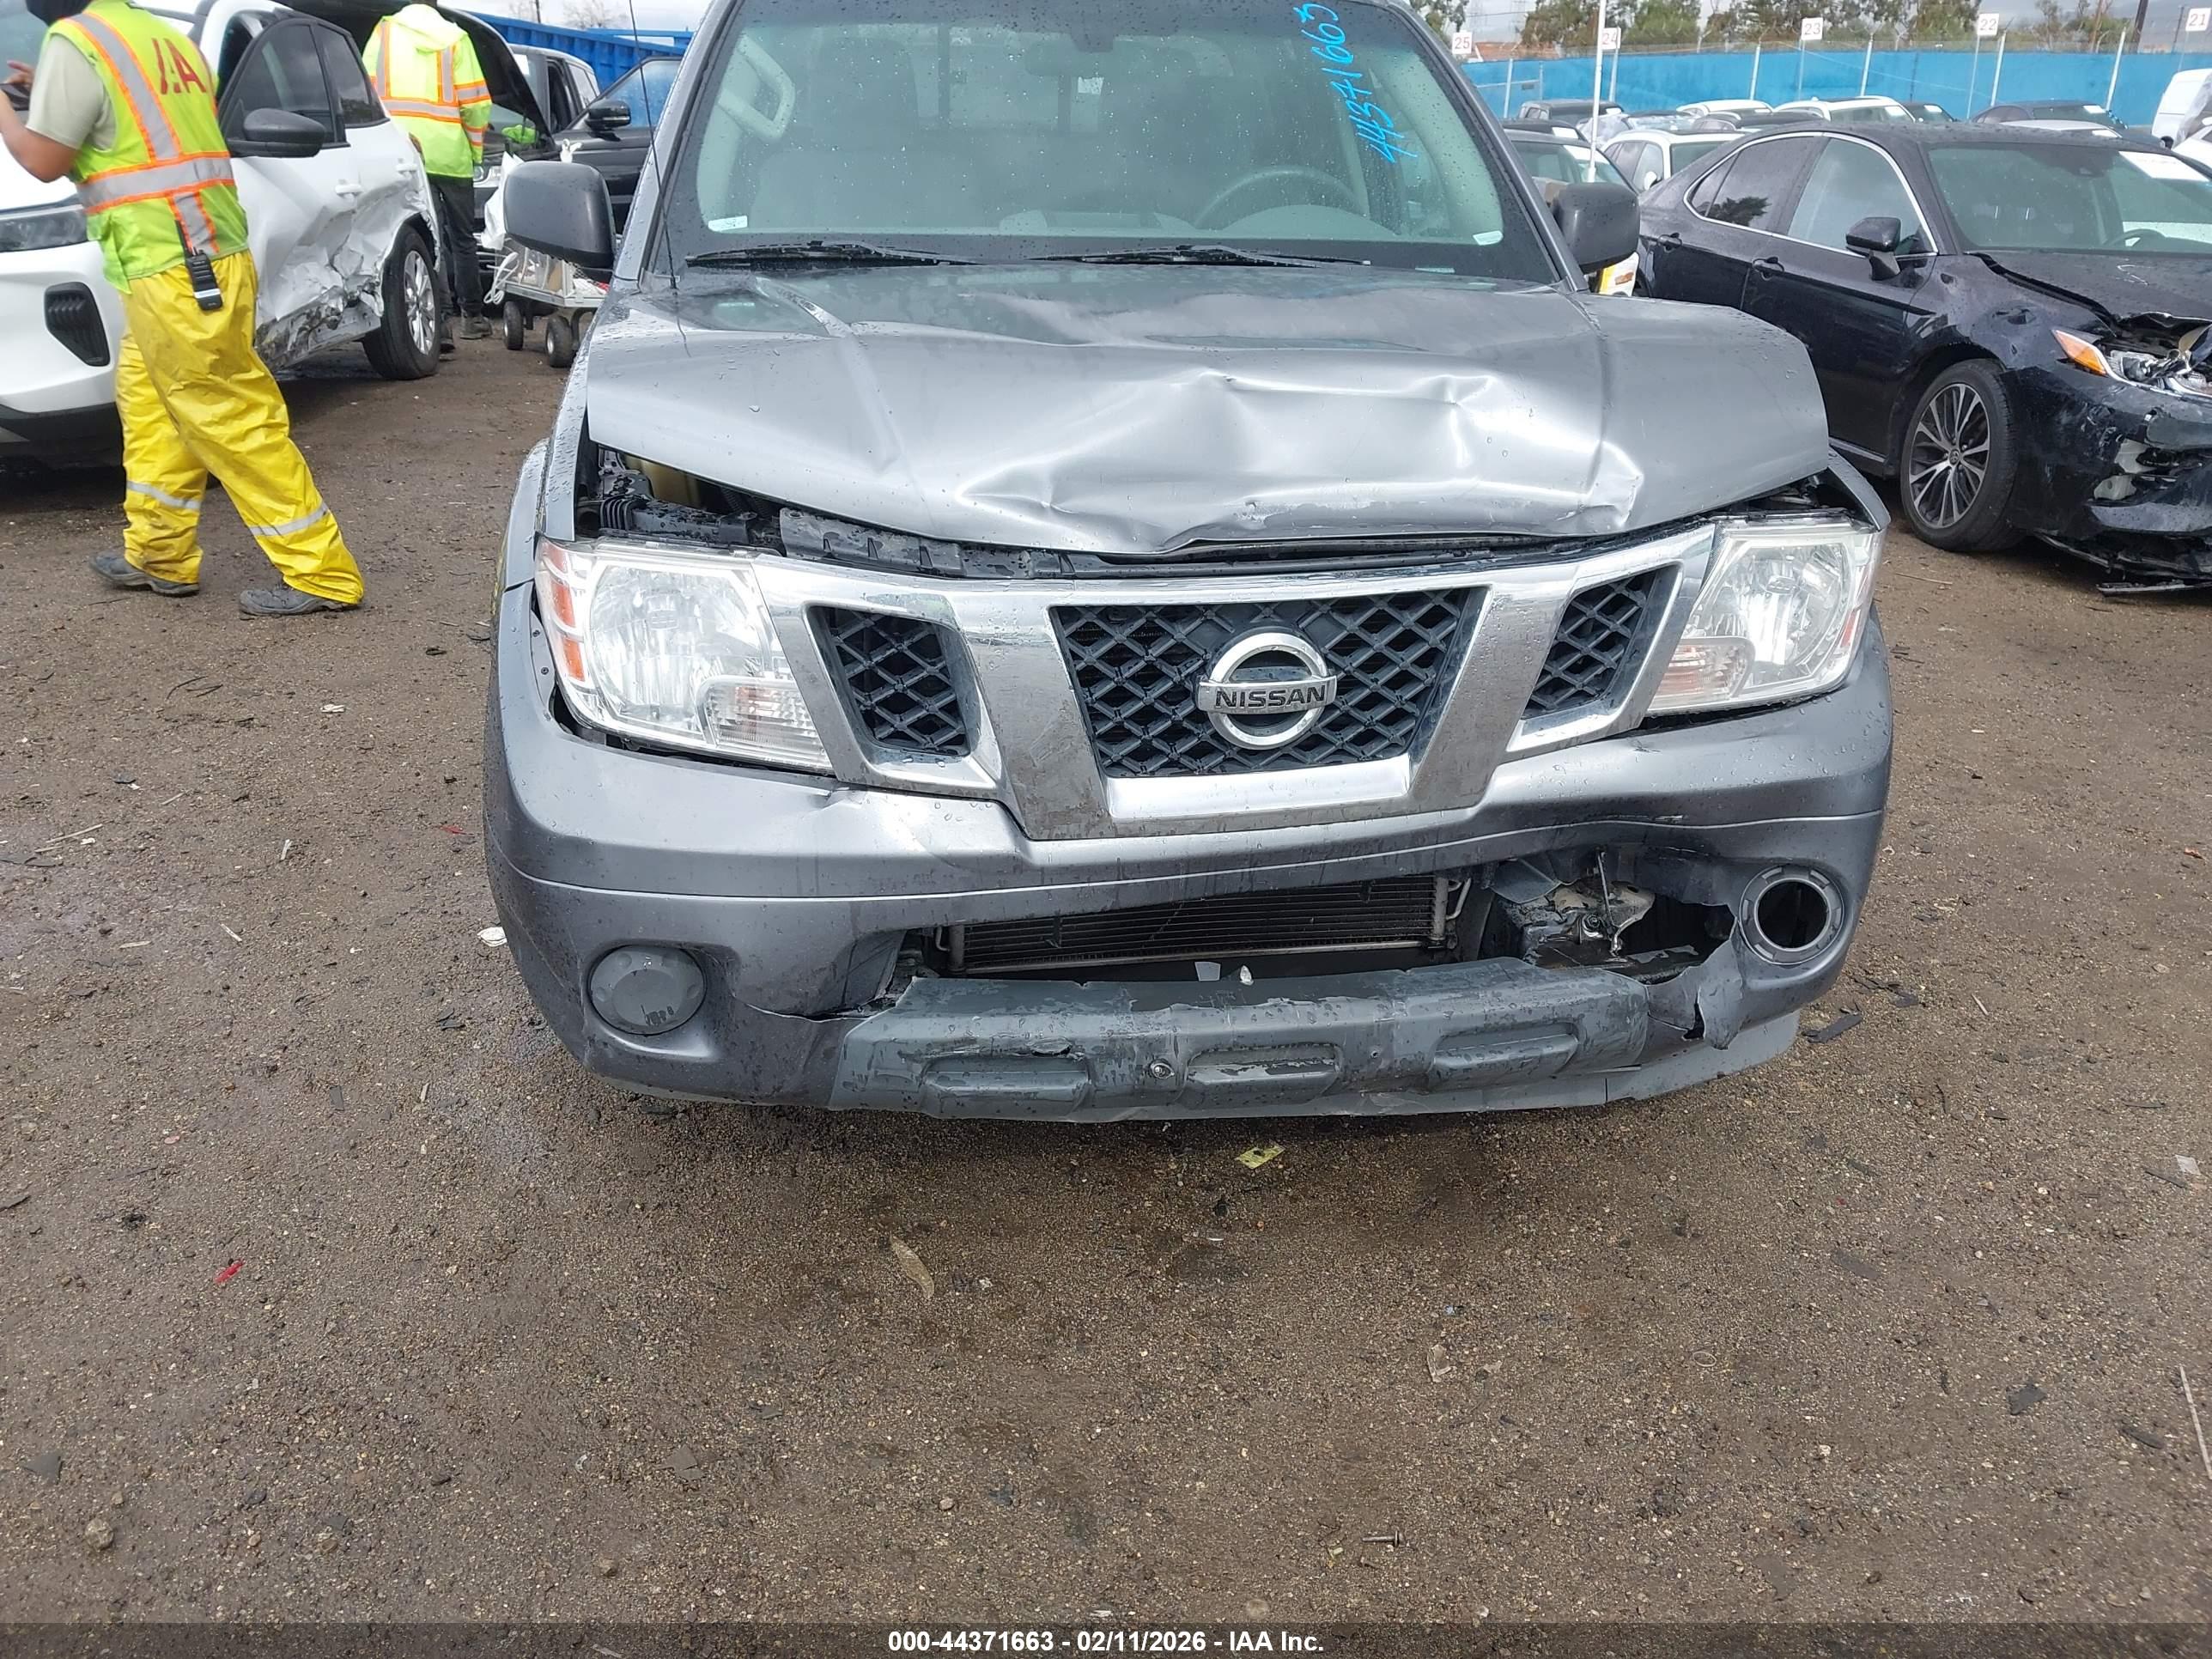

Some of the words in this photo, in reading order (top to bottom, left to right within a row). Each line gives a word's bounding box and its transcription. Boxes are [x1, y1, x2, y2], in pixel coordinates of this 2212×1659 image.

[1979, 18, 1996, 31] 22
[2189, 13, 2206, 27] 21
[1804, 22, 1821, 35] 23
[1455, 36, 1470, 50] 25
[1292, 3, 1419, 163] 44371663
[1215, 684, 1326, 708] NISSAN
